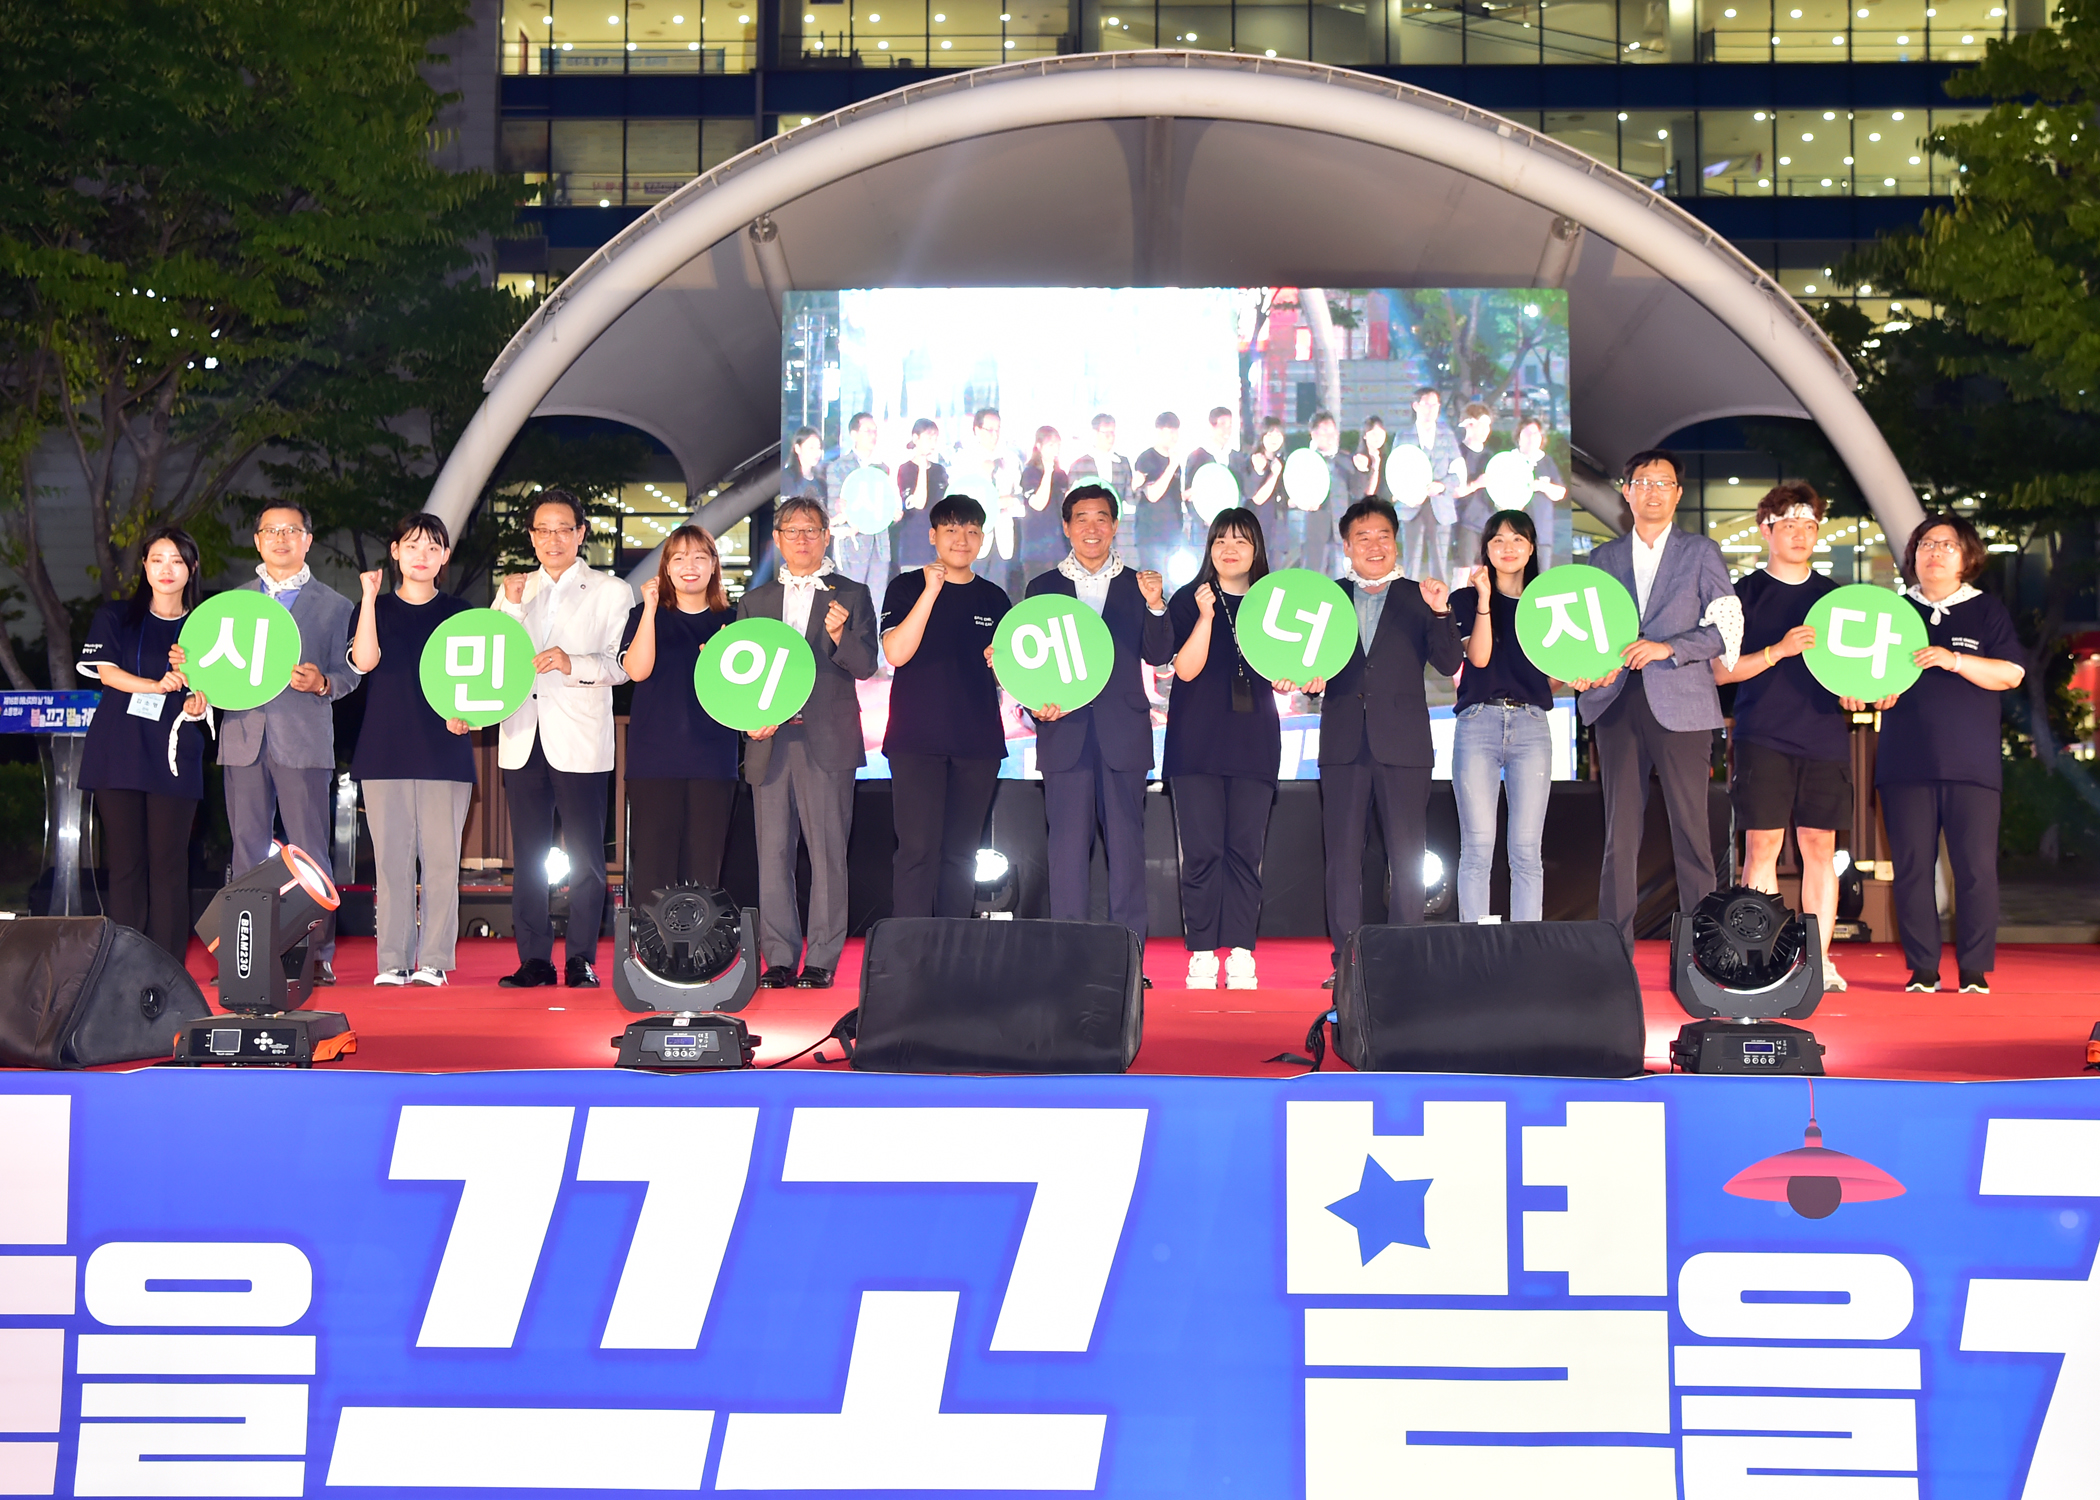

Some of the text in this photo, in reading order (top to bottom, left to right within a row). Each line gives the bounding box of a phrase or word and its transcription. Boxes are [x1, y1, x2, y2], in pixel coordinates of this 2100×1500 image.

[198, 616, 270, 687] 시
[1010, 613, 1089, 685] 에
[1261, 586, 1334, 668] 너
[1534, 586, 1611, 655] 지
[1826, 606, 1903, 680] 다
[444, 633, 506, 713] 민
[719, 639, 791, 711] 이
[239, 918, 250, 972] BEAM230
[0, 1094, 316, 1498] 을
